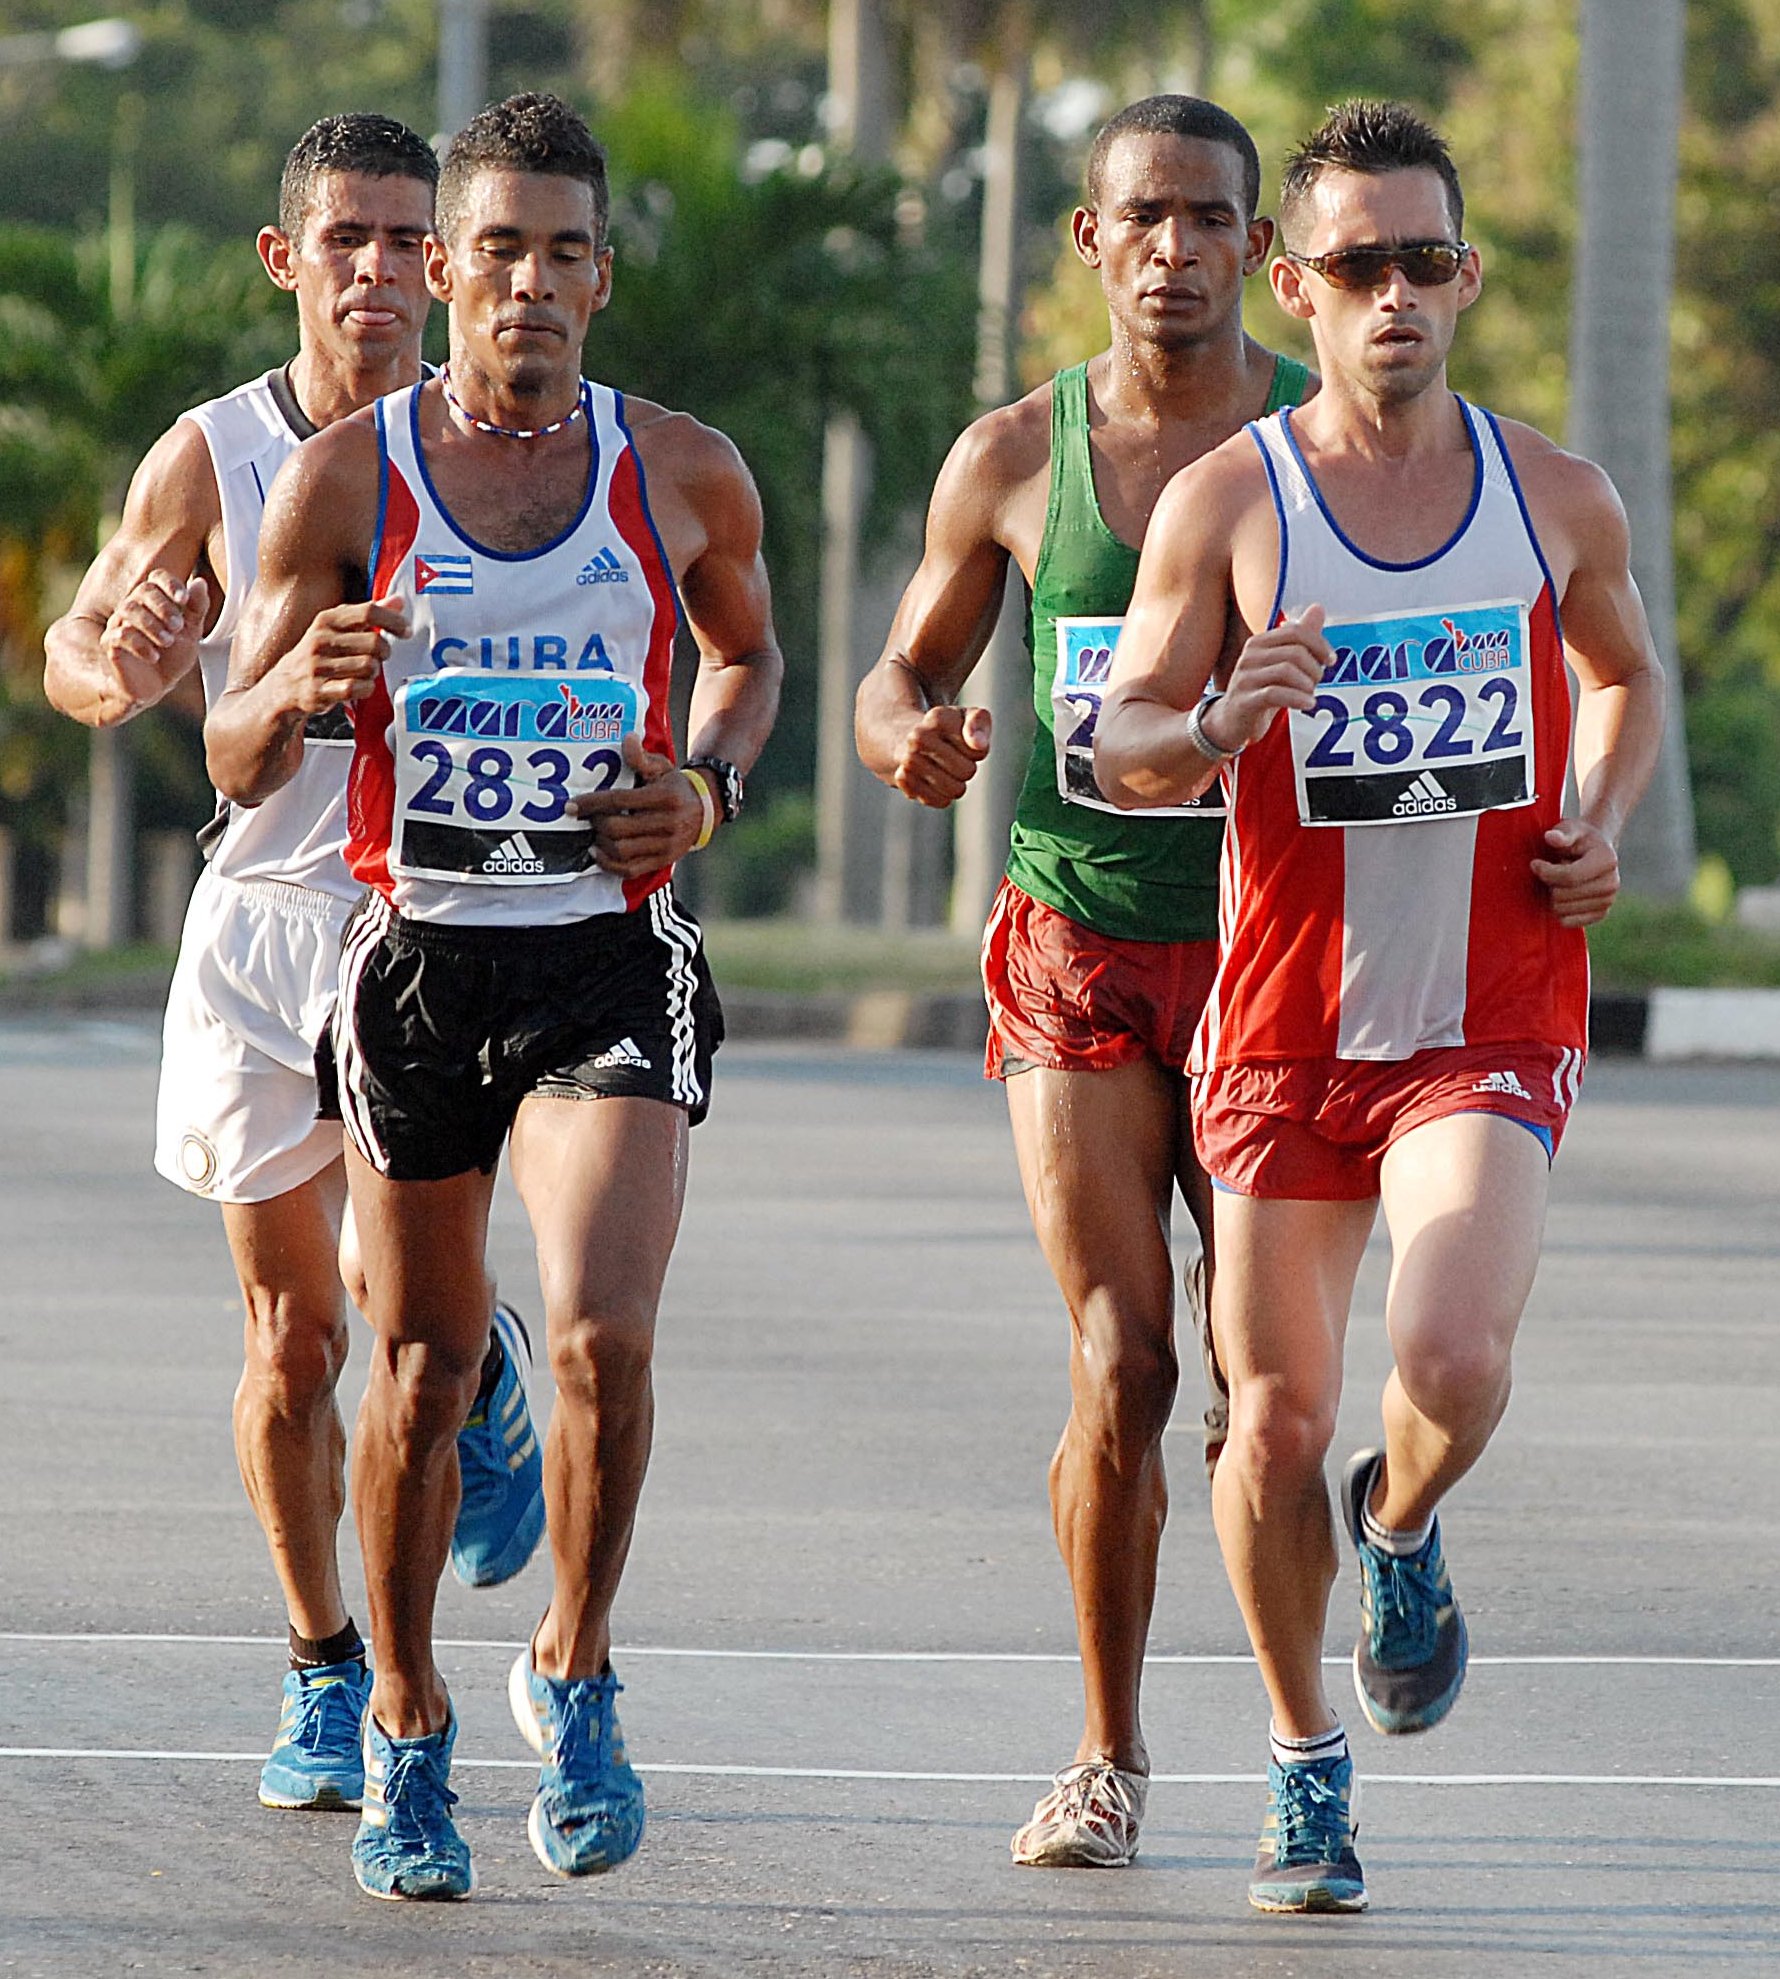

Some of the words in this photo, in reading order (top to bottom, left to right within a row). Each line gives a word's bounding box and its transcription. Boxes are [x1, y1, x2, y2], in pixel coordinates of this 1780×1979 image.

[576, 569, 629, 586] adidas
[431, 634, 614, 670] CUBA
[1457, 648, 1511, 673] CUBA
[568, 720, 621, 739] CUBA
[1301, 677, 1523, 768] 2822
[407, 741, 622, 823] 2832
[1392, 797, 1457, 816] adidas
[482, 855, 545, 873] adidas
[593, 1052, 652, 1069] adidas
